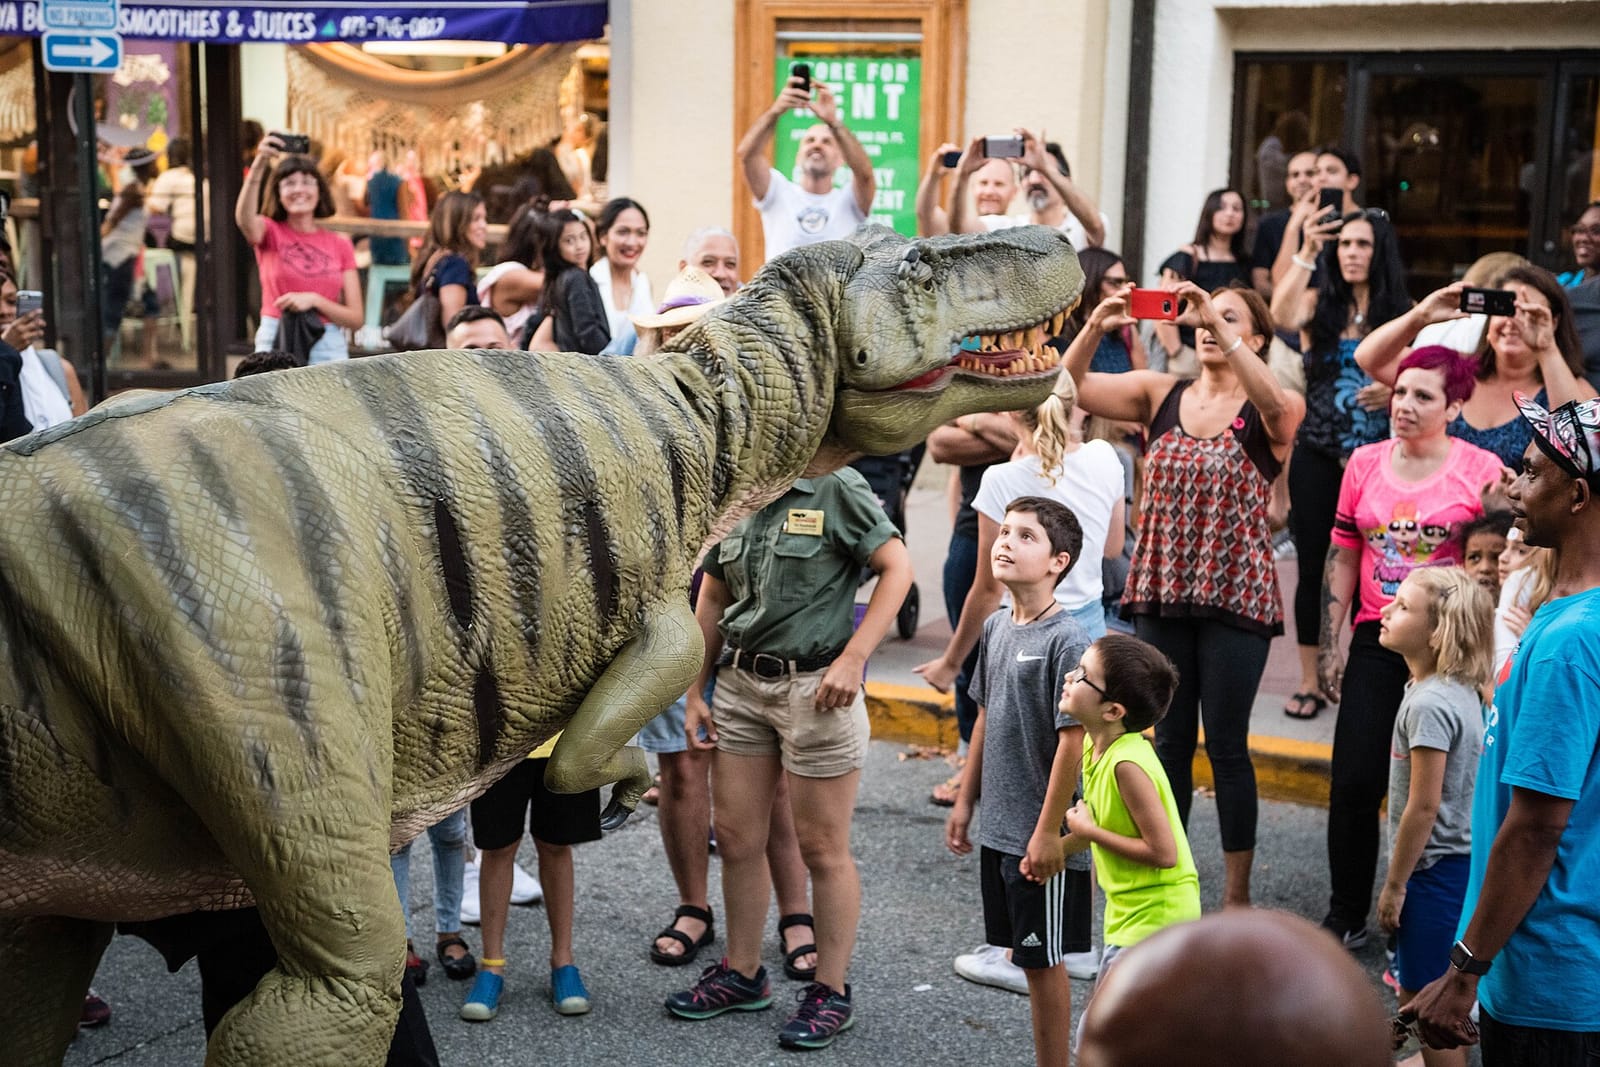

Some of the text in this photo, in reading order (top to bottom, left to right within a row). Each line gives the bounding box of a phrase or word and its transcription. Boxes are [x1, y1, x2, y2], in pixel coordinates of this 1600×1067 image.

[119, 8, 221, 38] SMOOTHIES
[225, 10, 245, 38] &
[248, 10, 317, 40] JUICES
[866, 62, 909, 83] FOR
